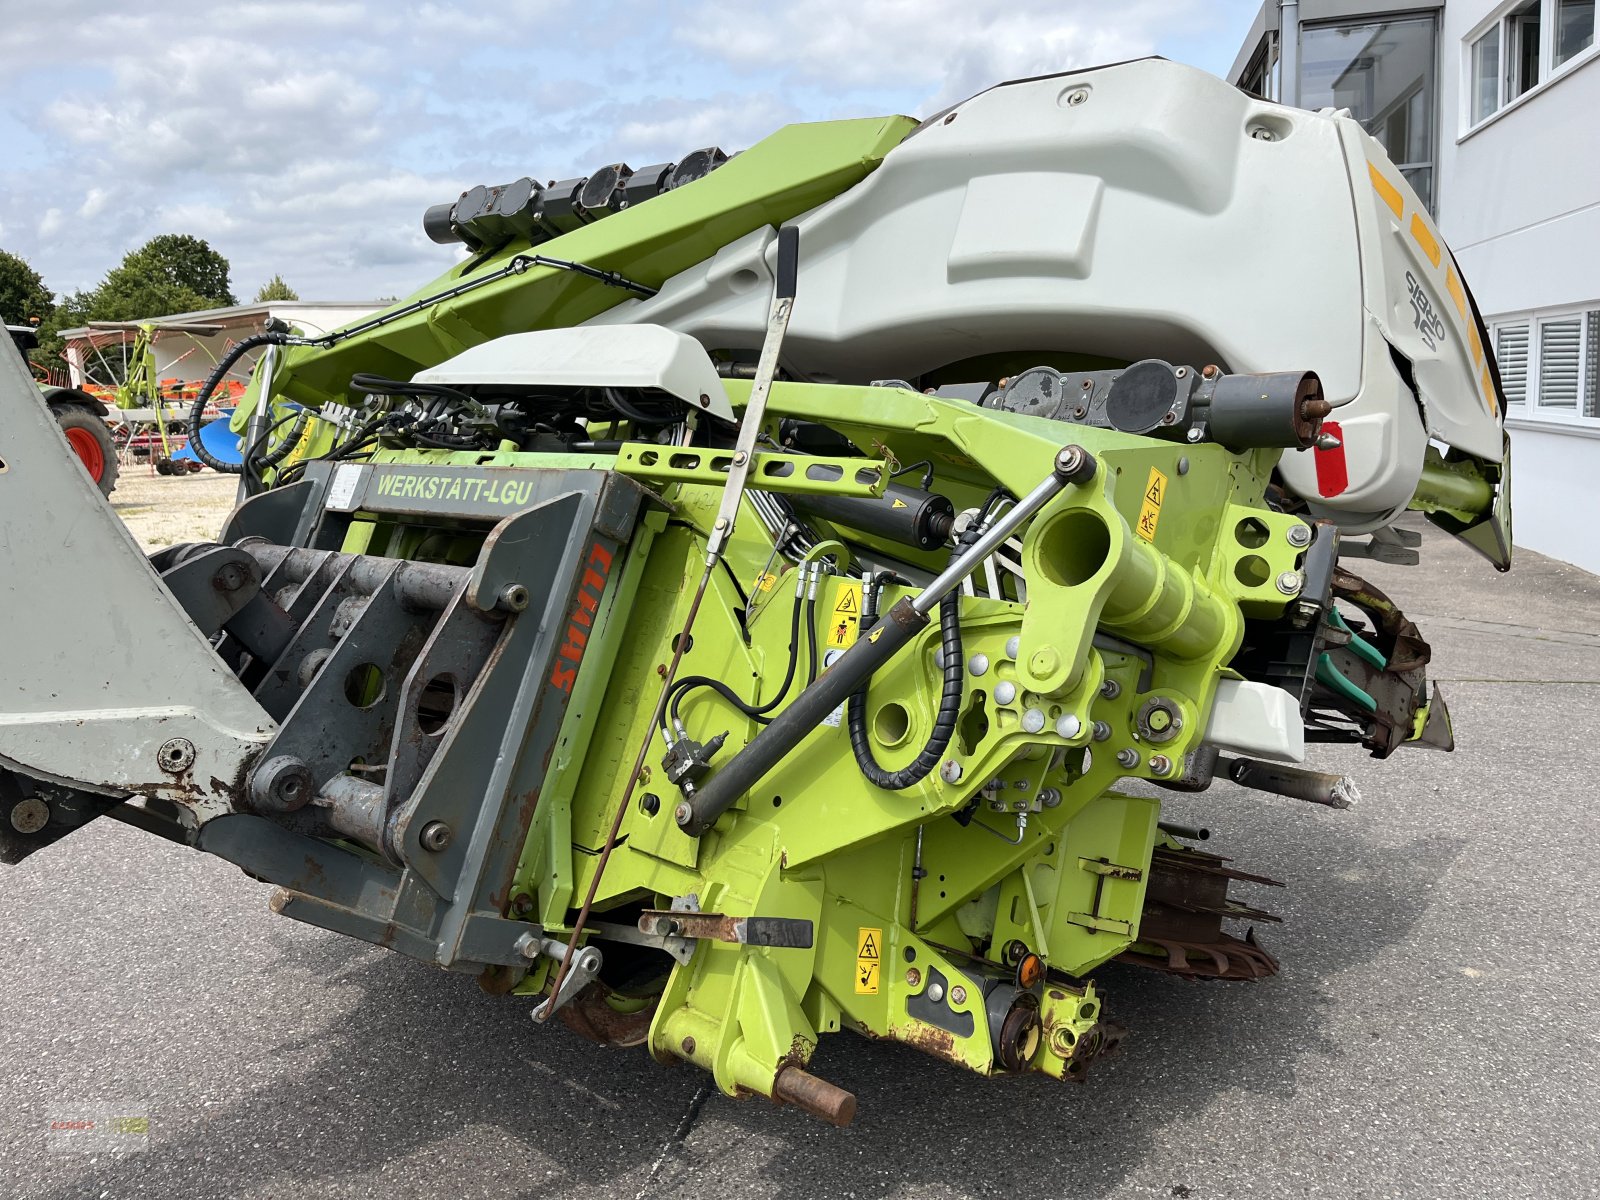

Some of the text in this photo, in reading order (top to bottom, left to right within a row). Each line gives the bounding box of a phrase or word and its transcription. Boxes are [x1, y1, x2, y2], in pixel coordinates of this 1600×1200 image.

[1405, 270, 1446, 342] ORBIS
[376, 474, 534, 505] WERKSTATT-LGU
[550, 542, 614, 695] CLAAS
